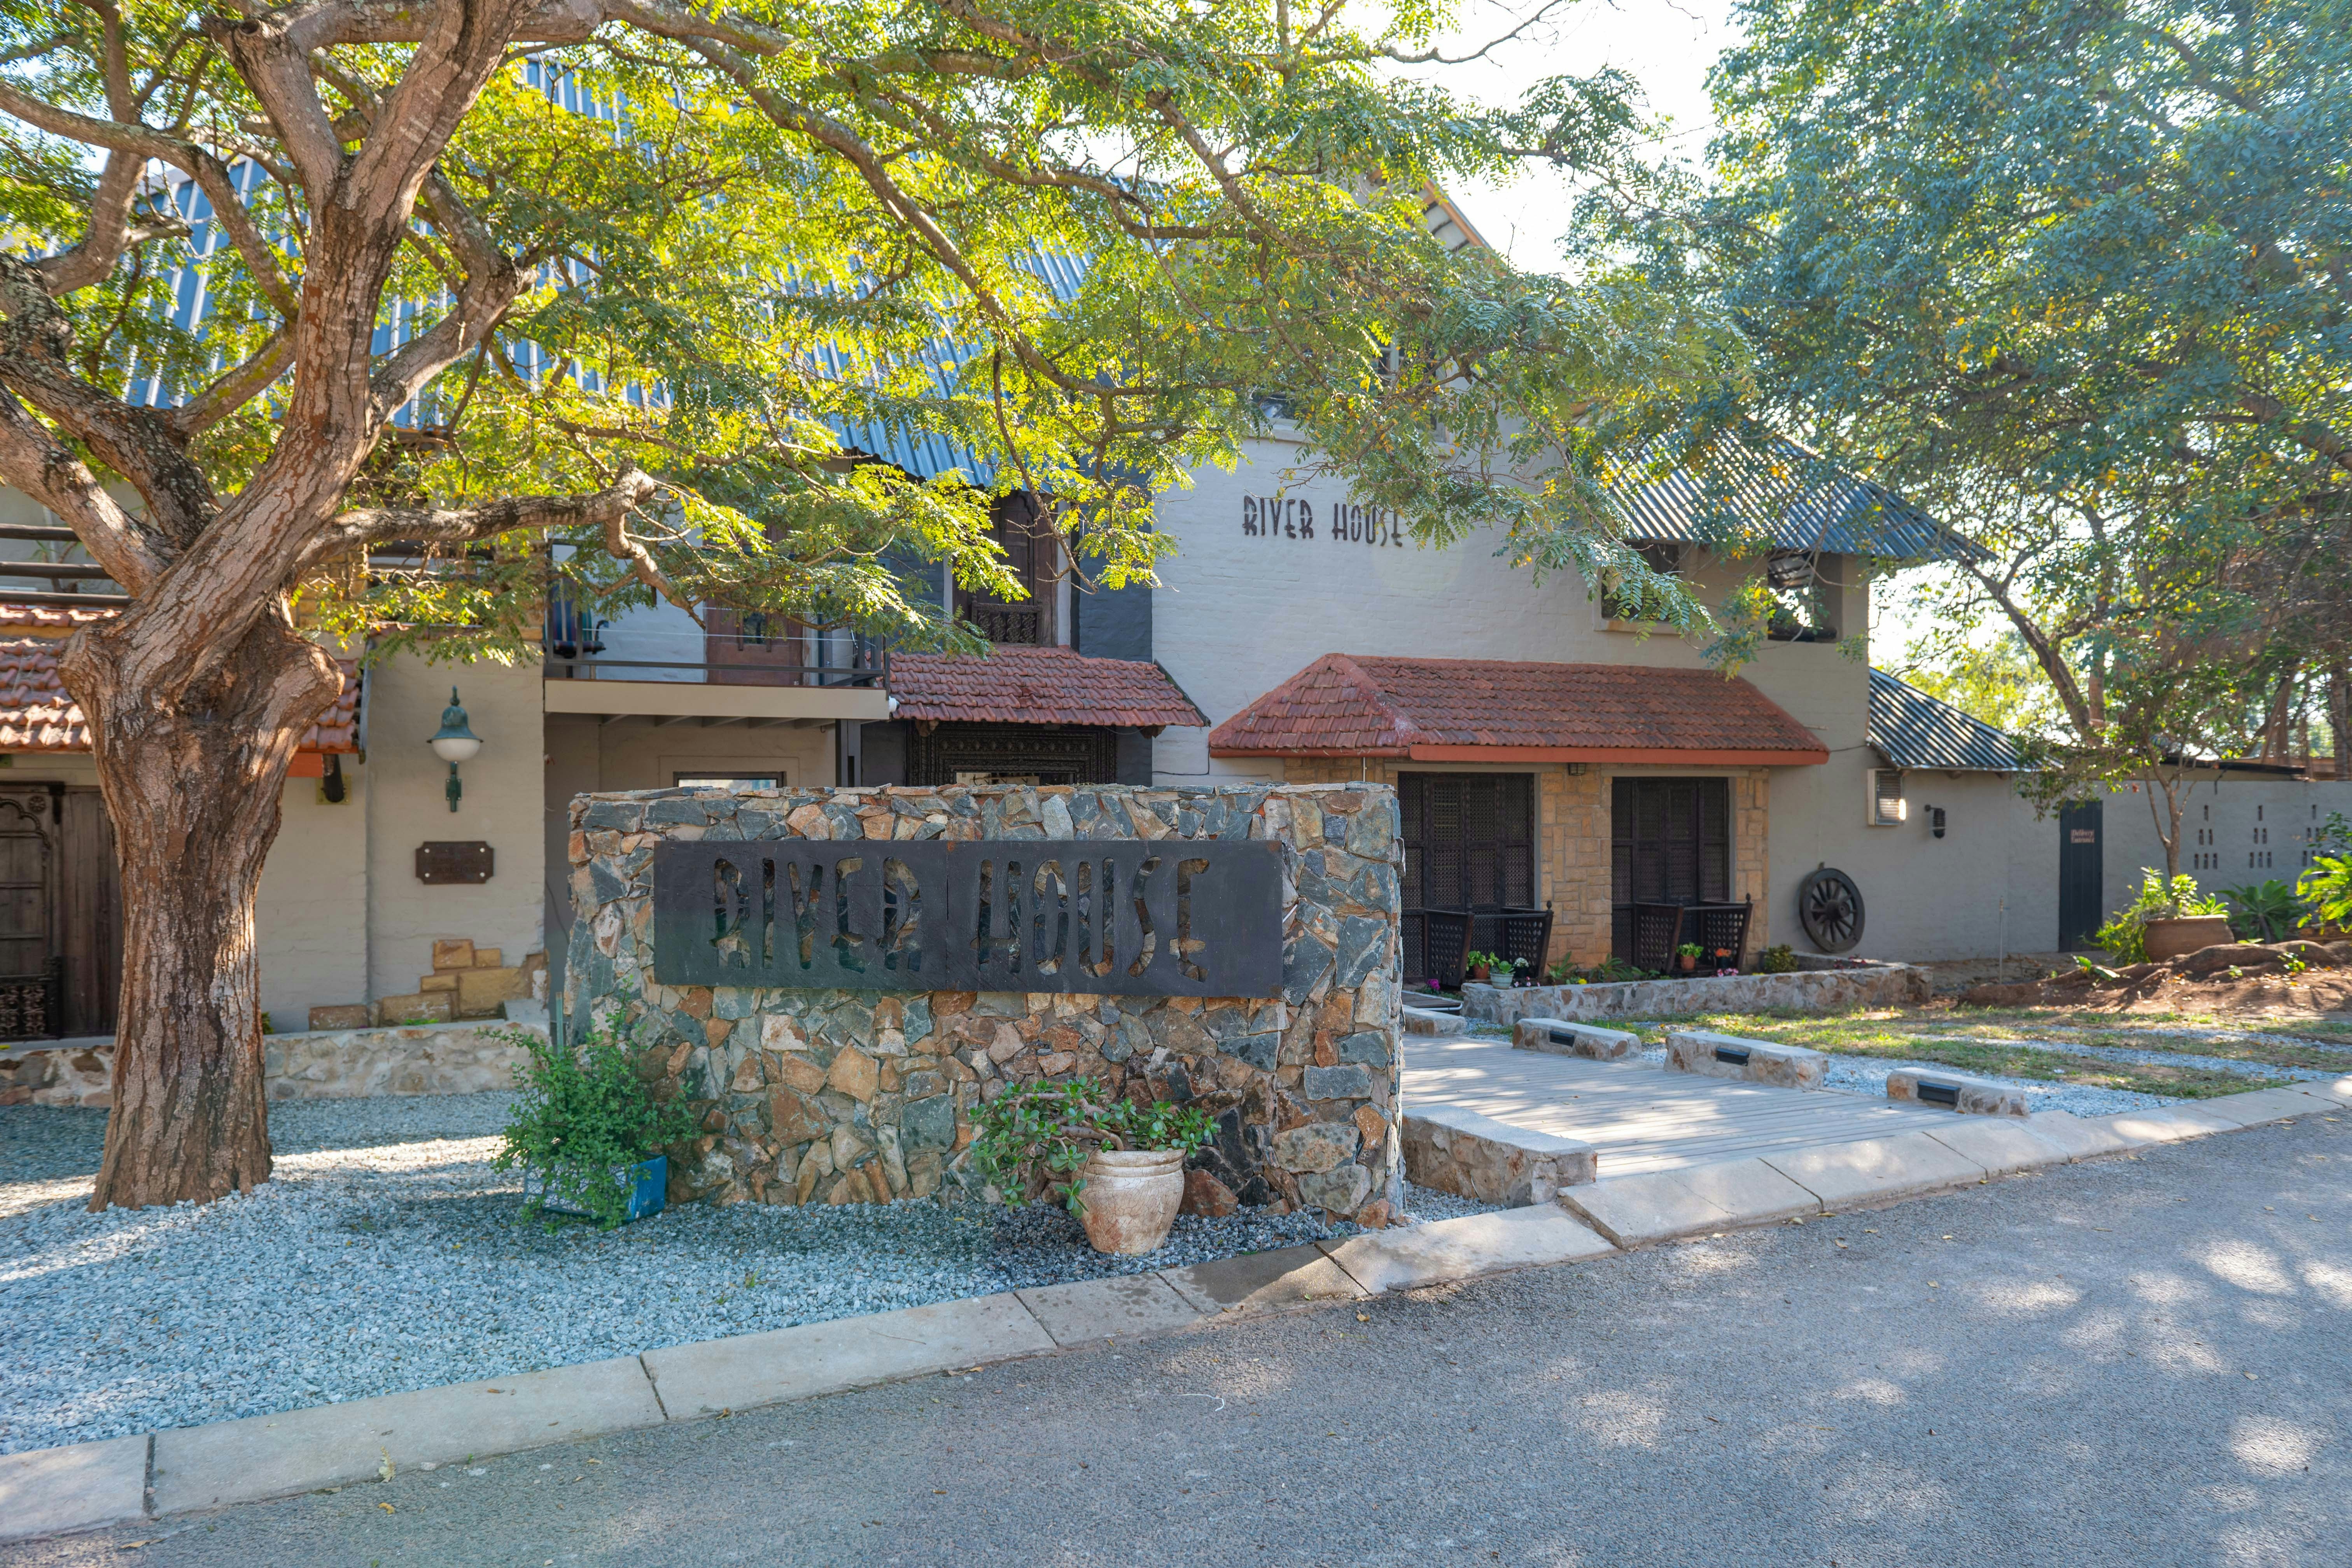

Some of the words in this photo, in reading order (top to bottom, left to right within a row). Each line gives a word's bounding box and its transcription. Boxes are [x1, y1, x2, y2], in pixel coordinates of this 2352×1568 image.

[1242, 495, 1314, 539] RIVER
[1332, 502, 1403, 547] HOUSE
[709, 857, 922, 974] RIVER
[970, 856, 1210, 983] HOUSE
